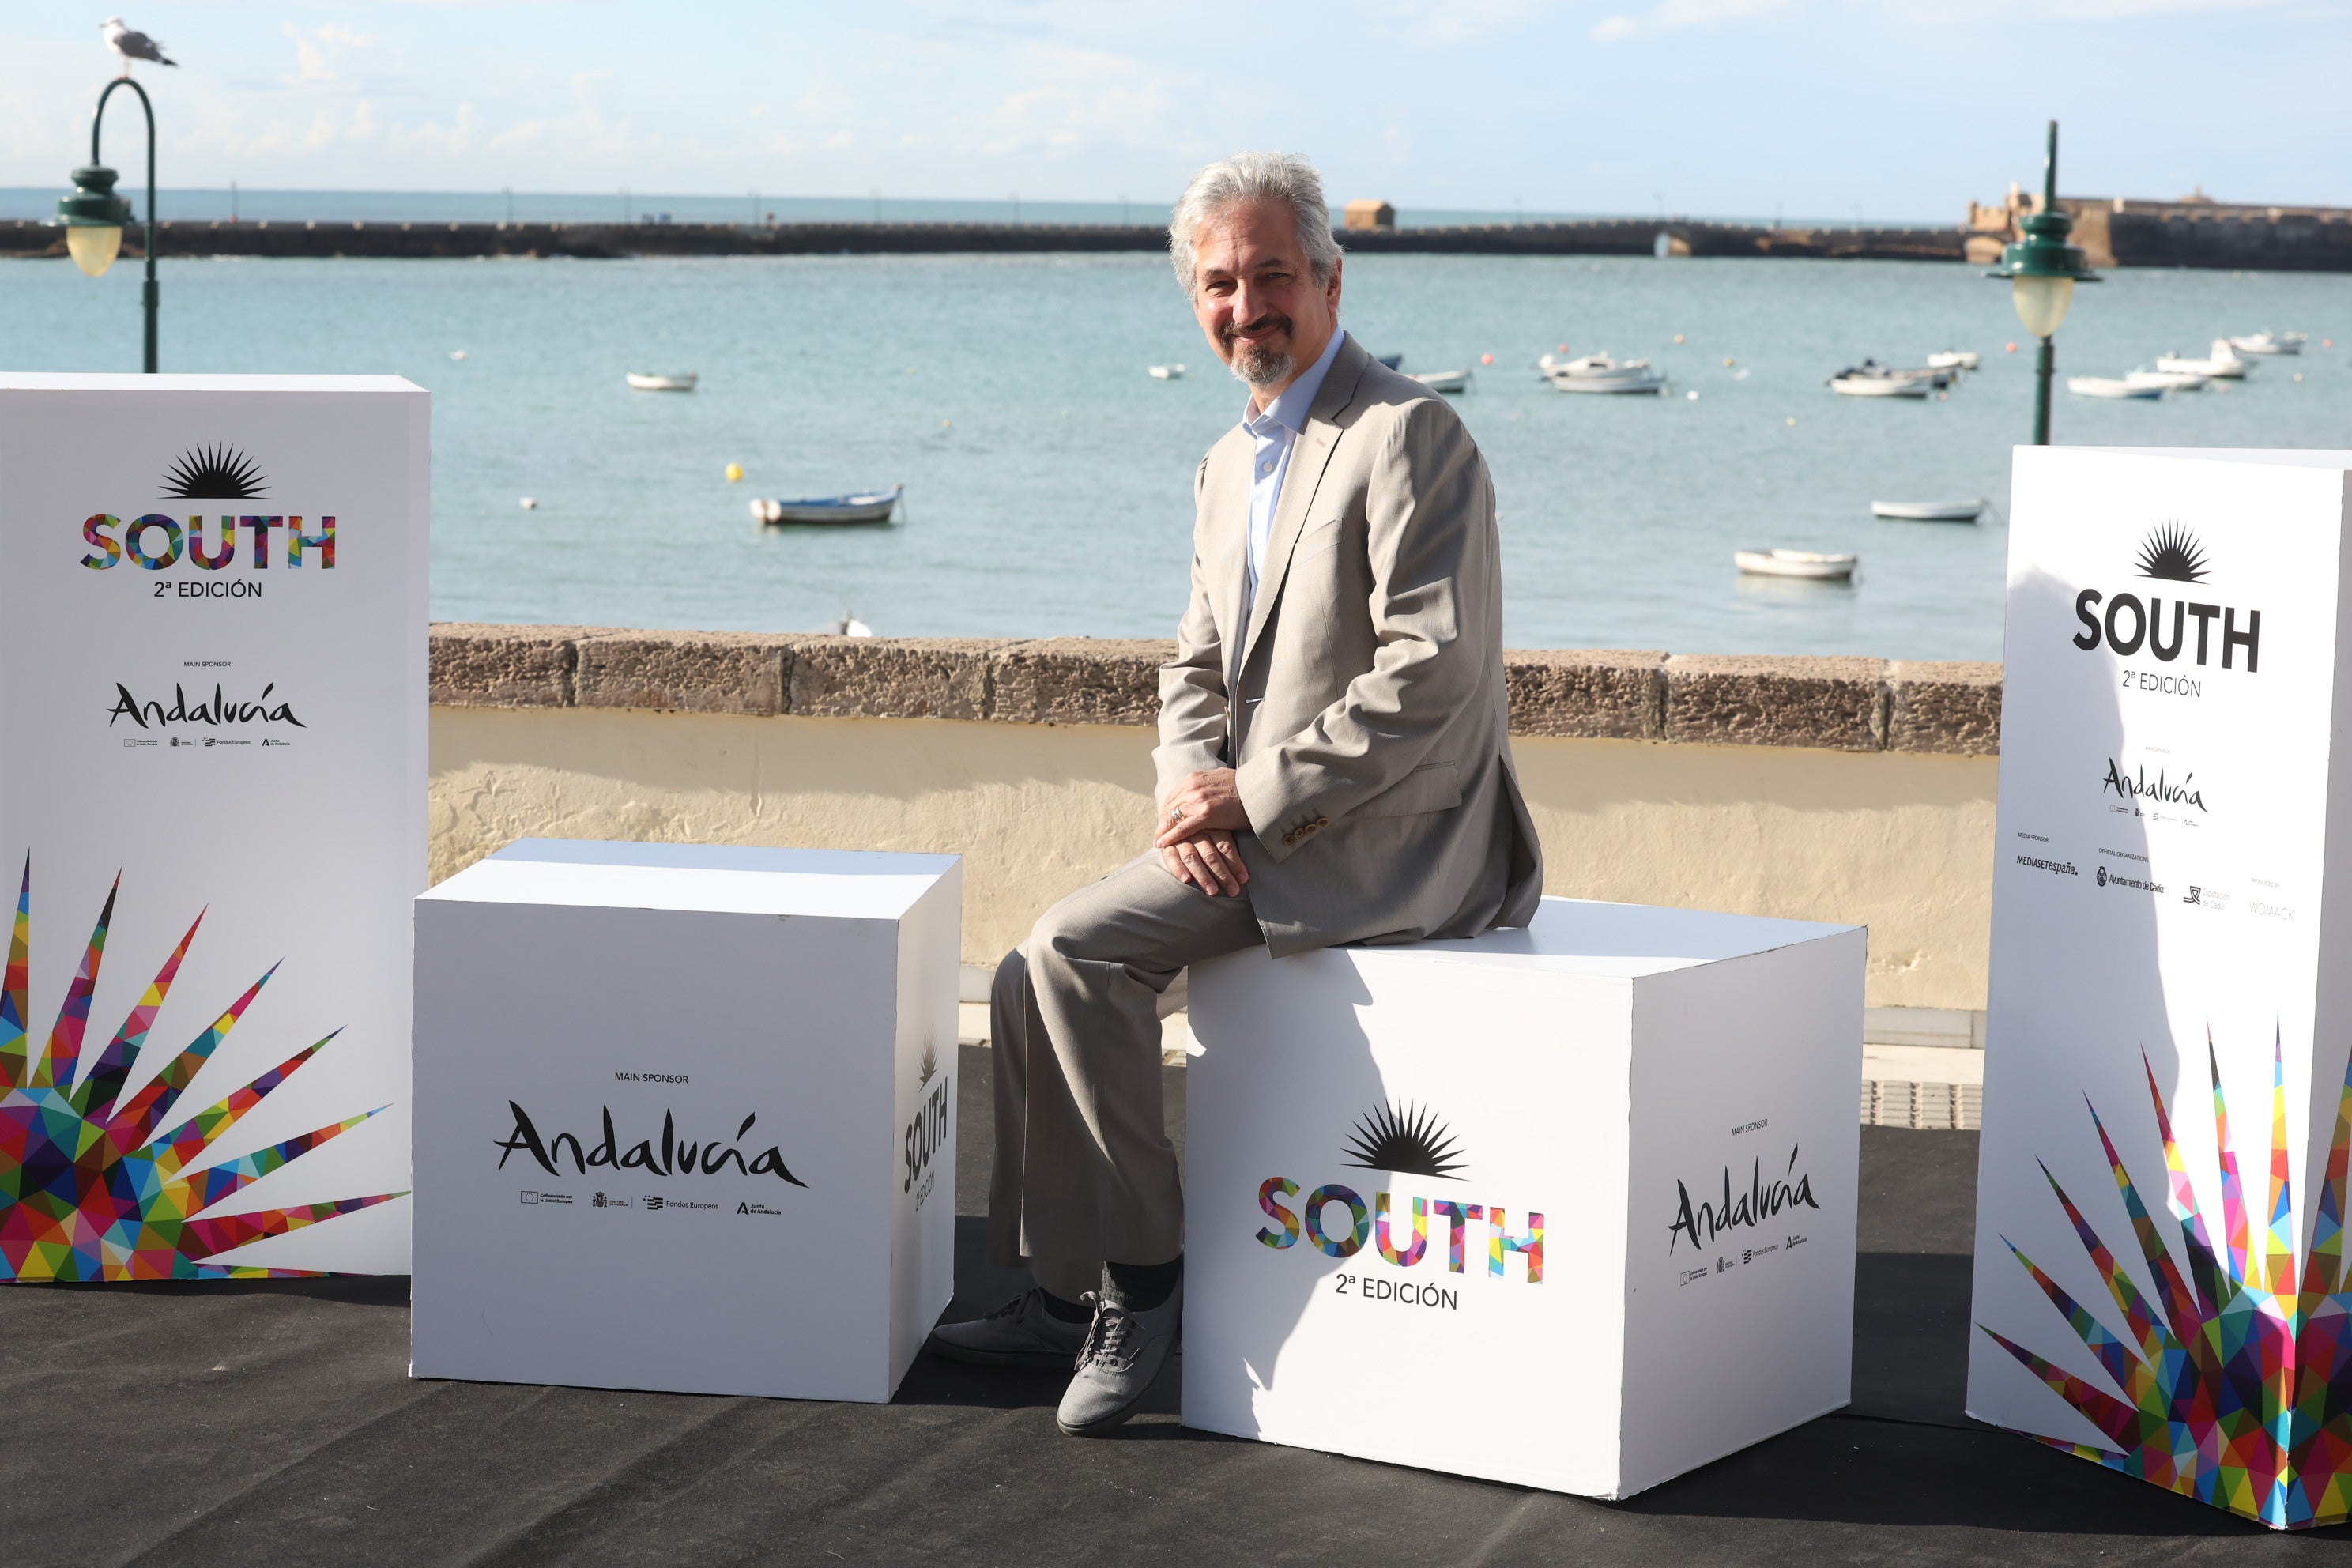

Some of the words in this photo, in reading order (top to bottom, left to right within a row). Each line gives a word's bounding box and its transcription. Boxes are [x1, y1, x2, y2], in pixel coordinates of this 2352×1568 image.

[80, 513, 336, 571] SOUTH
[153, 581, 172, 597] 2ª
[178, 579, 262, 598] EDICIÓN
[2072, 588, 2260, 673] SOUTH
[2122, 669, 2135, 688] 2ª
[2139, 673, 2201, 699] EDICIÓN
[106, 682, 307, 729] Andalucía
[2103, 756, 2208, 813] Andalucía
[2030, 834, 2049, 842] SPONSOR
[2098, 847, 2116, 857] OFFICIAL
[2116, 851, 2149, 863] ORGANIZATIONS
[2109, 874, 2142, 889] Ayuntamiento
[2142, 881, 2150, 890] de
[2150, 882, 2165, 893] Cádiz
[2249, 901, 2295, 921] WOMACK
[615, 1072, 640, 1082] MAIN
[643, 1073, 689, 1084] SPONSOR
[904, 1076, 948, 1194] SOUTH
[1732, 1125, 1744, 1136] MAIN
[1745, 1118, 1768, 1133] SPONSOR
[493, 1099, 810, 1189] Andalucía
[690, 1201, 719, 1210] Europeos
[1668, 1142, 1821, 1257] Andalucía
[1255, 1176, 1544, 1285] SOUTH
[1752, 1249, 1764, 1257] Fondos
[1764, 1244, 1778, 1254] Europeos
[1336, 1273, 1355, 1295] 2ª
[1363, 1277, 1457, 1310] EDICIÓN
